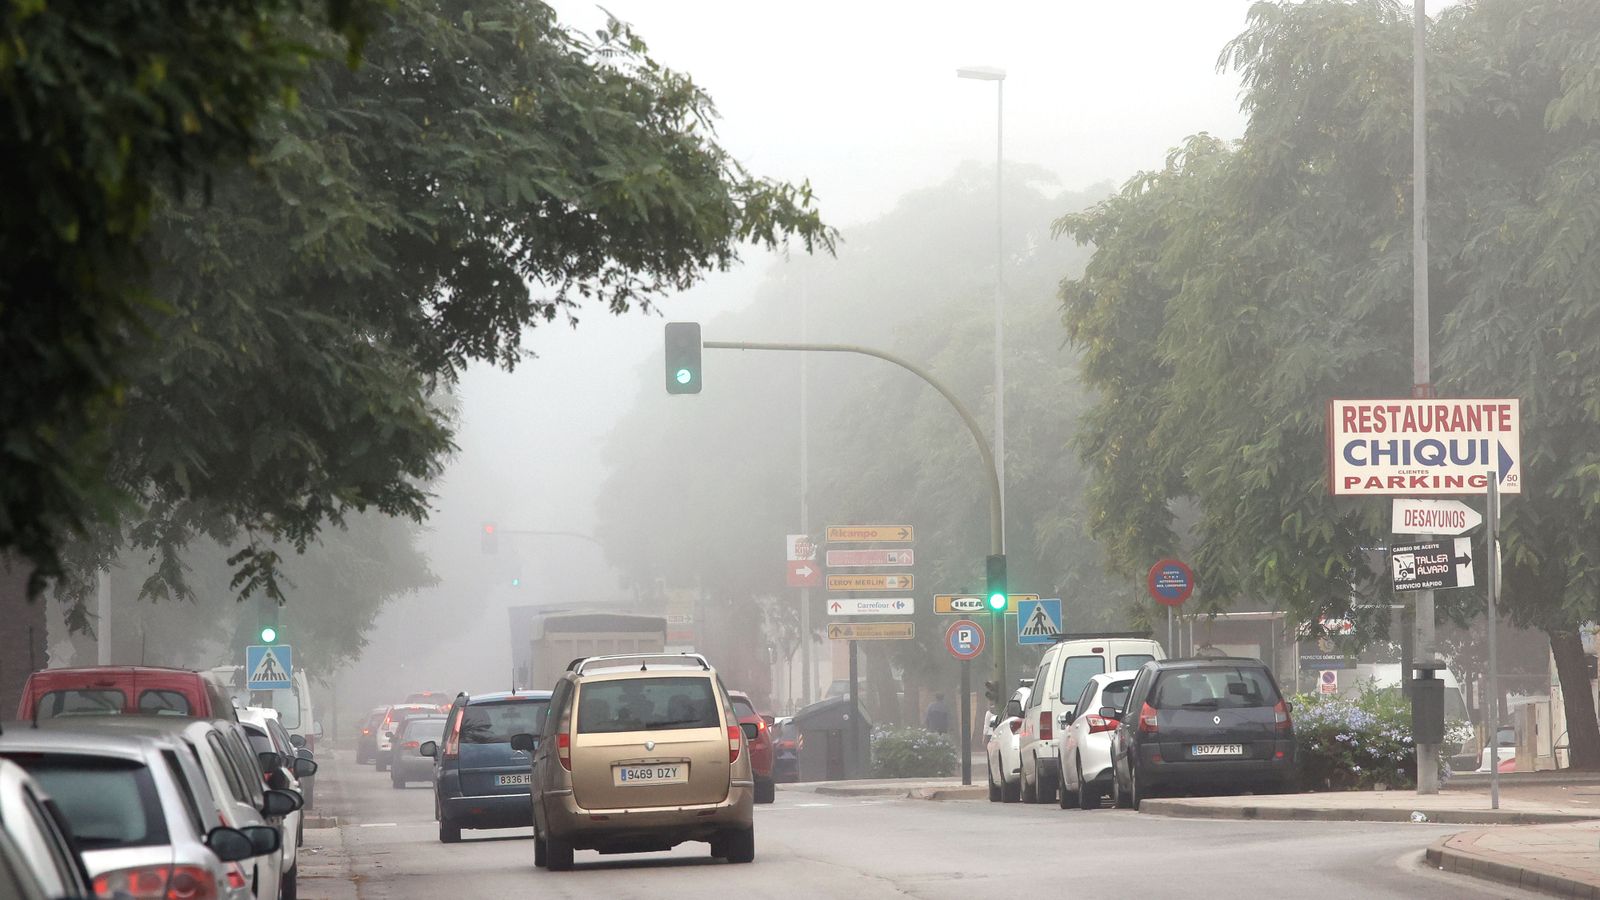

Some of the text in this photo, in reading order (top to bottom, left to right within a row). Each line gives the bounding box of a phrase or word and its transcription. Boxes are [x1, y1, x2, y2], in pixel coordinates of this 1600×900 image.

[1342, 404, 1512, 433] RESTAURANTE
[1343, 438, 1489, 467] CHIQUI
[1344, 474, 1488, 489] PARKING
[1506, 474, 1518, 482] 50
[1404, 509, 1466, 528] DESAYUNOS
[1415, 553, 1449, 565] TALLER
[1417, 564, 1449, 576] ÁLVARO
[855, 578, 885, 586] MERLIN
[1395, 580, 1443, 591] SERVICIO RÁPIDO
[857, 601, 890, 609] Carrefour
[960, 631, 969, 641] P
[1197, 744, 1241, 754] 9077 FRT
[627, 767, 678, 780] 9469 DZY
[500, 775, 522, 784] 8336
